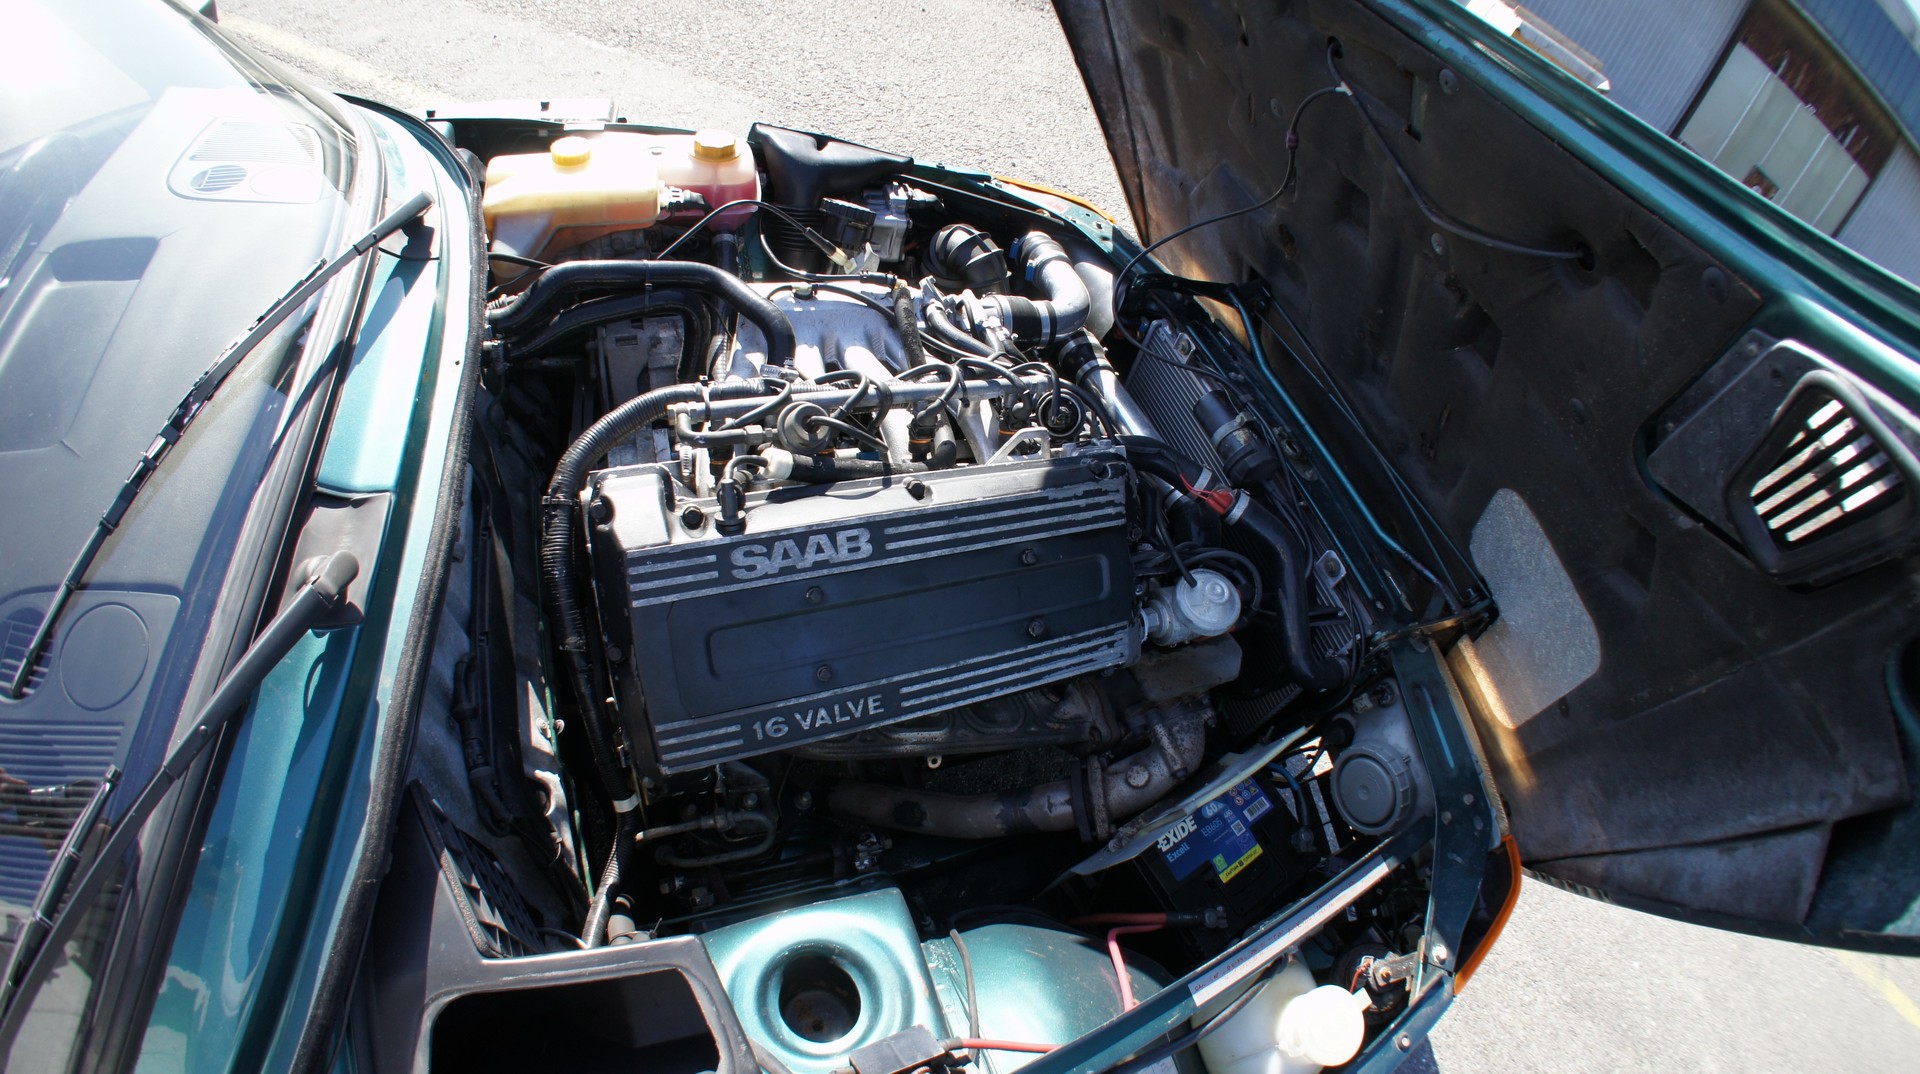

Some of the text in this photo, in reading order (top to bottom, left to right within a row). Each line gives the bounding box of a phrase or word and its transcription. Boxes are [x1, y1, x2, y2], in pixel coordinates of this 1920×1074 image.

[730, 527, 873, 580] SAAB
[752, 694, 885, 741] 16 VALVE
[1205, 802, 1218, 816] 60
[1157, 815, 1198, 852] EXIDE
[1166, 842, 1191, 863] Excell
